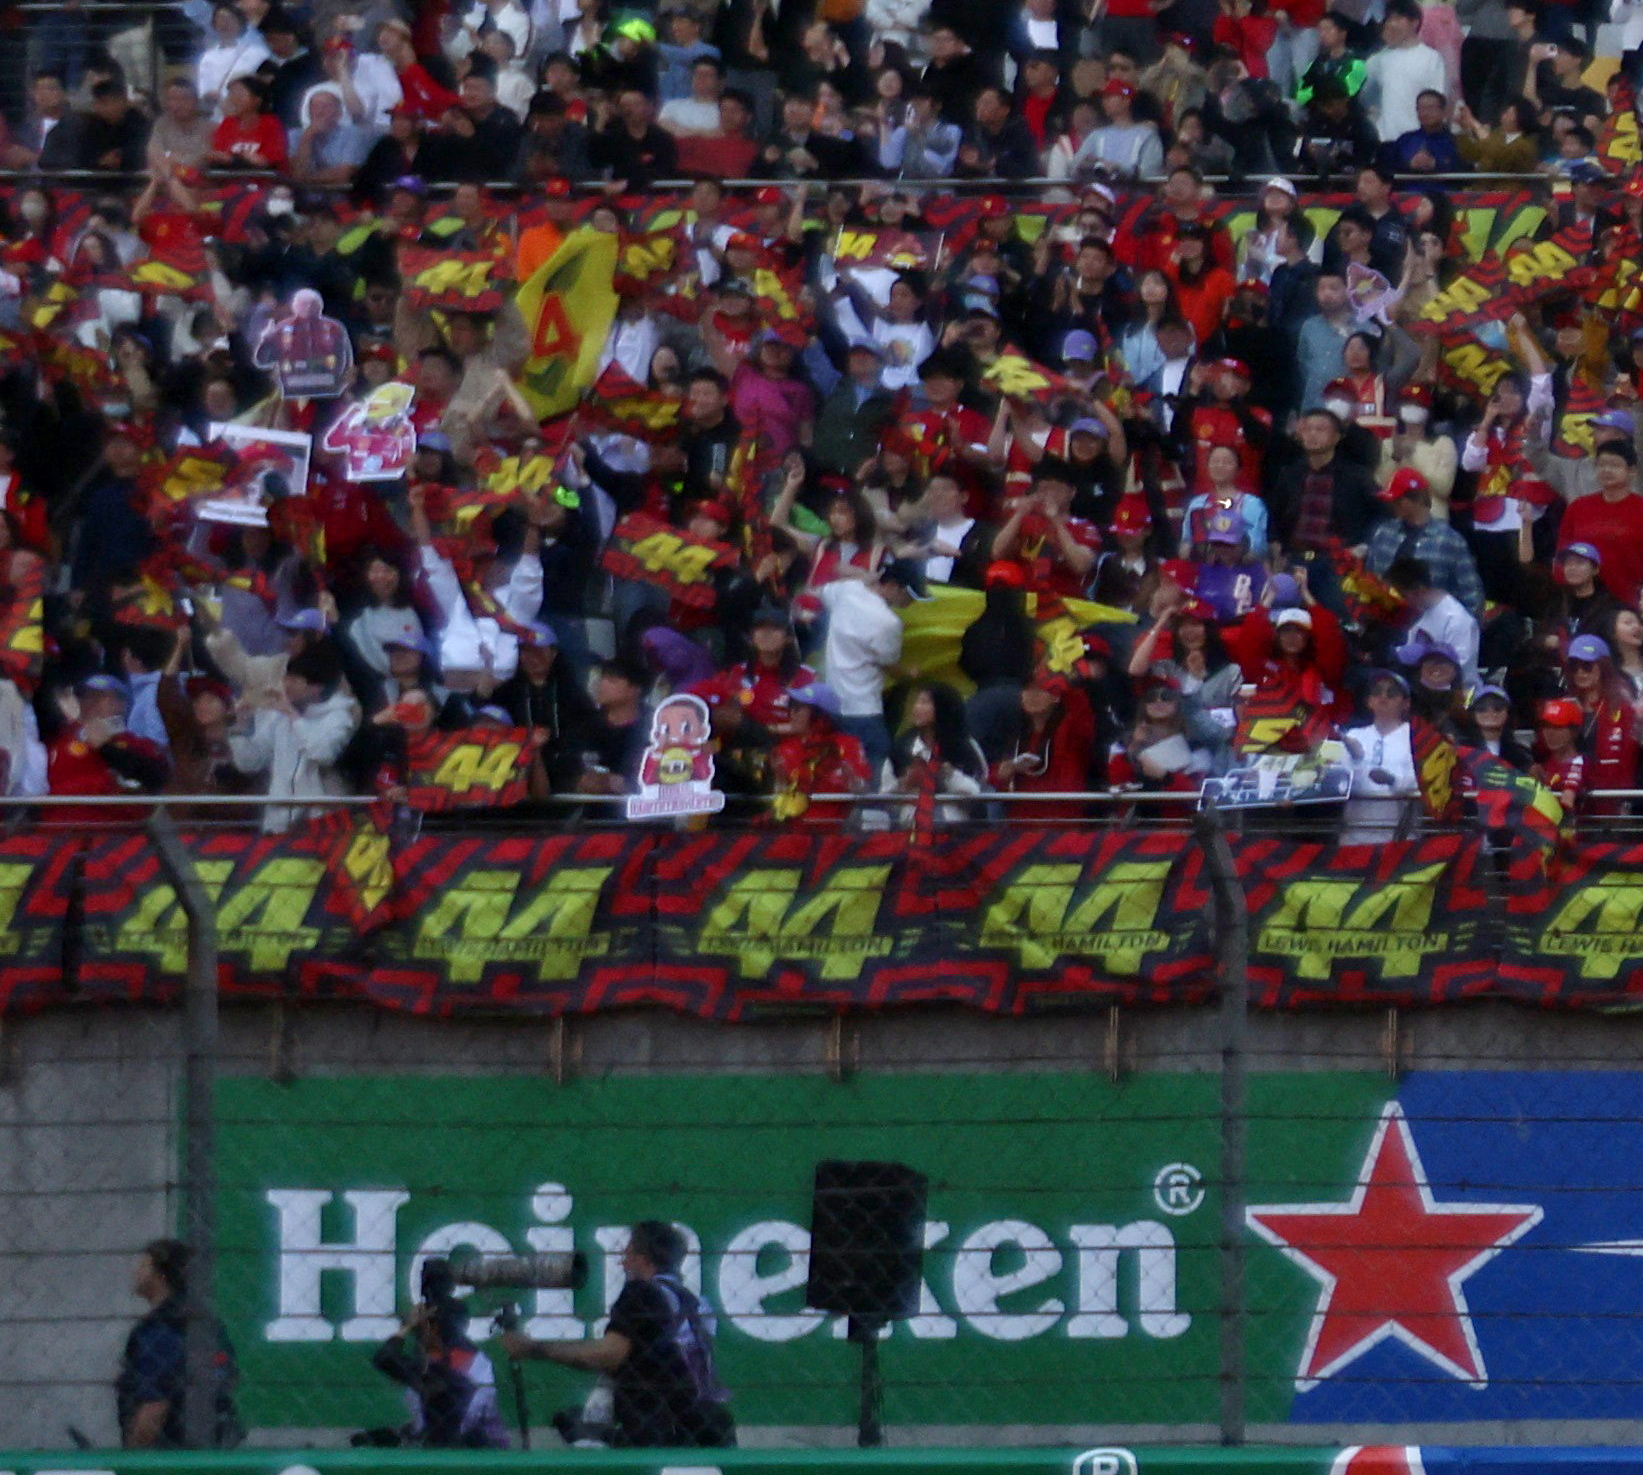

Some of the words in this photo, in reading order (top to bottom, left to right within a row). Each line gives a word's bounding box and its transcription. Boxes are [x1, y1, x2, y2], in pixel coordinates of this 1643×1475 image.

[435, 741, 521, 793] 44
[413, 866, 614, 983] 44
[697, 862, 894, 982] 44
[773, 935, 885, 954] HAMILTON
[978, 860, 1174, 977] 44
[1051, 932, 1162, 952] HAMILTON
[1256, 862, 1449, 981] 44
[1264, 934, 1321, 953] LEWIS
[1327, 931, 1440, 954] HAMILTON
[1549, 936, 1611, 956] LEWIS
[265, 1181, 1194, 1342] Hieen
